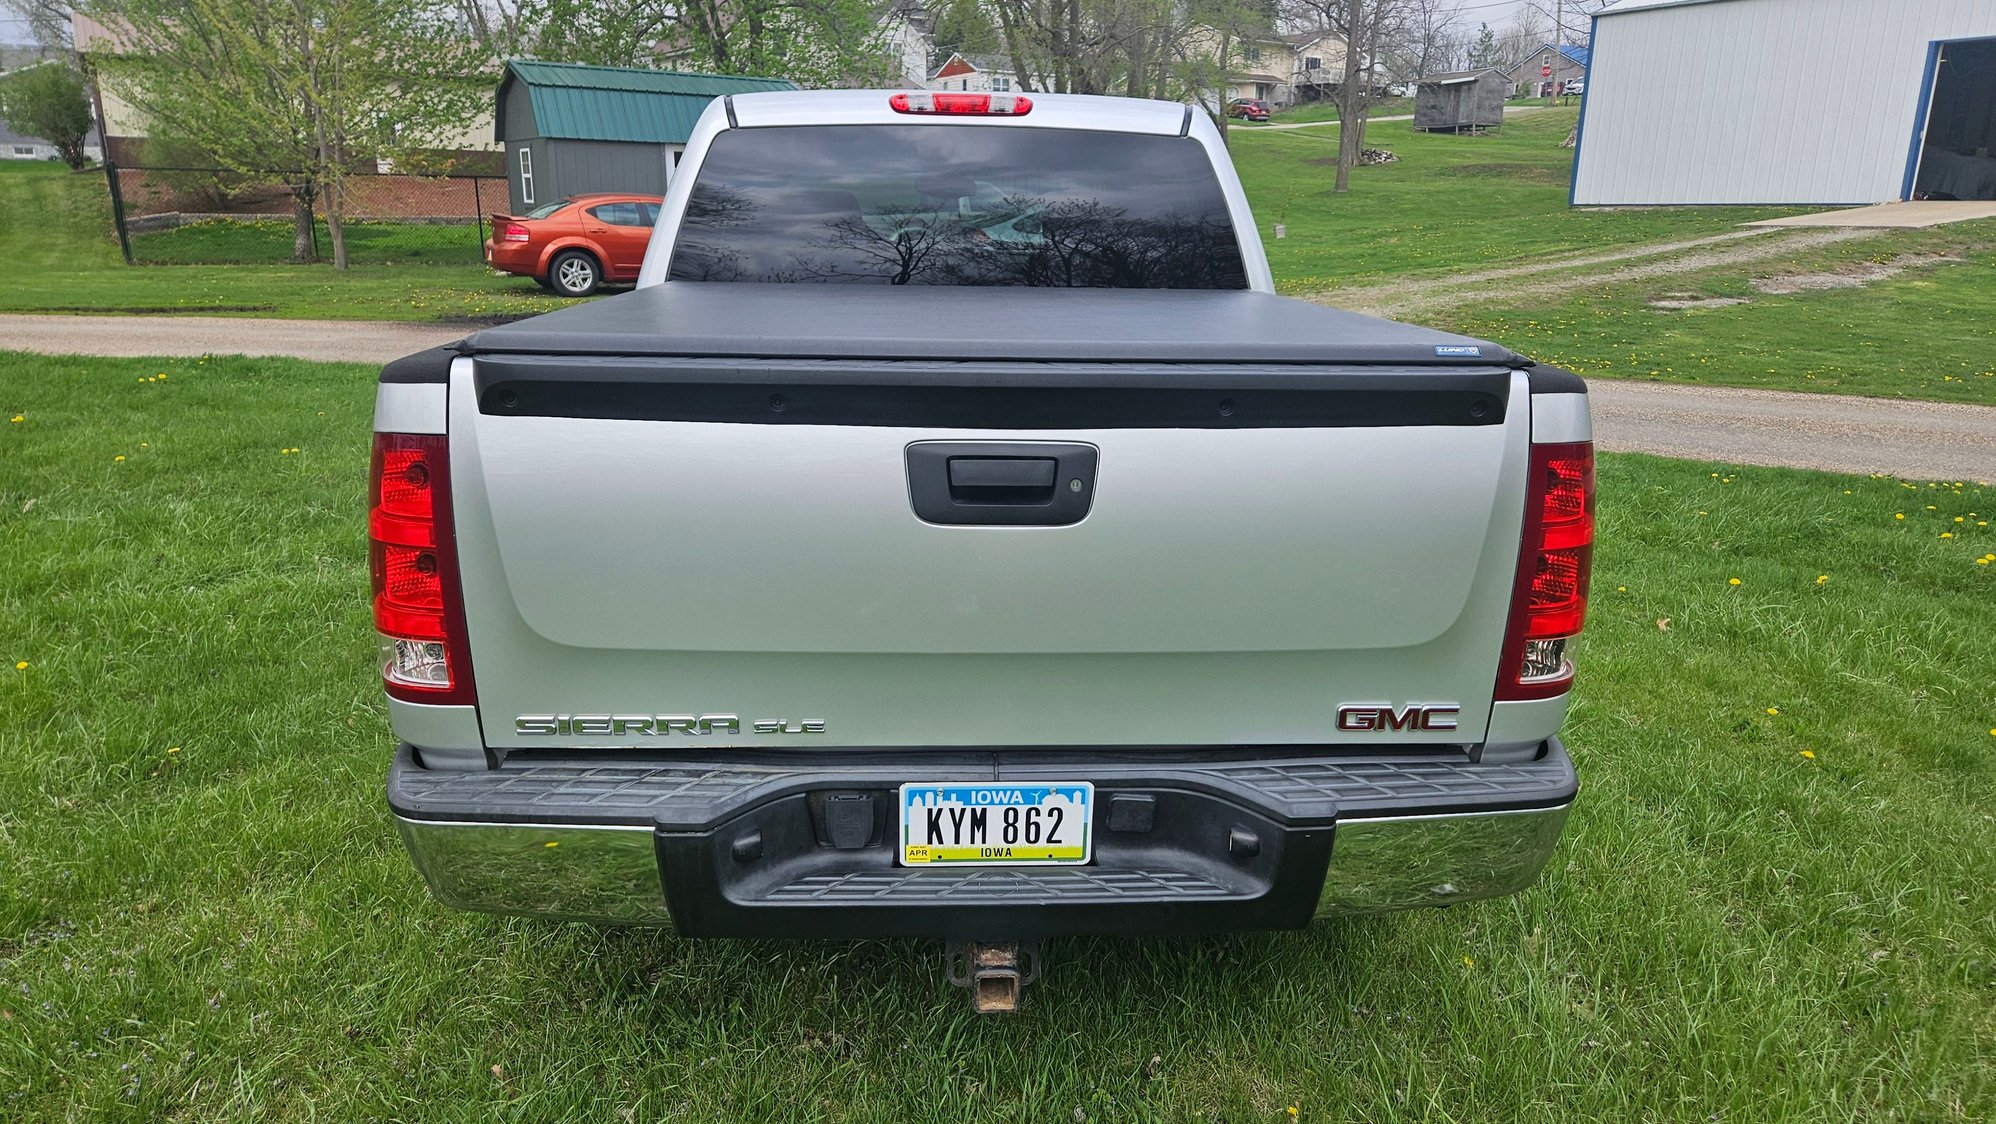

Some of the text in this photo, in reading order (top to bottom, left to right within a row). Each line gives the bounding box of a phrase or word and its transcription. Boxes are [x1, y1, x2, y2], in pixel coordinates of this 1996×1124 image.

[515, 713, 826, 736] SIERRA SLE
[1336, 702, 1460, 732] GMC
[971, 790, 1024, 805] IOWA
[927, 806, 1064, 845] KYM 862
[909, 849, 928, 857] APR
[980, 847, 1012, 858] IOWA
